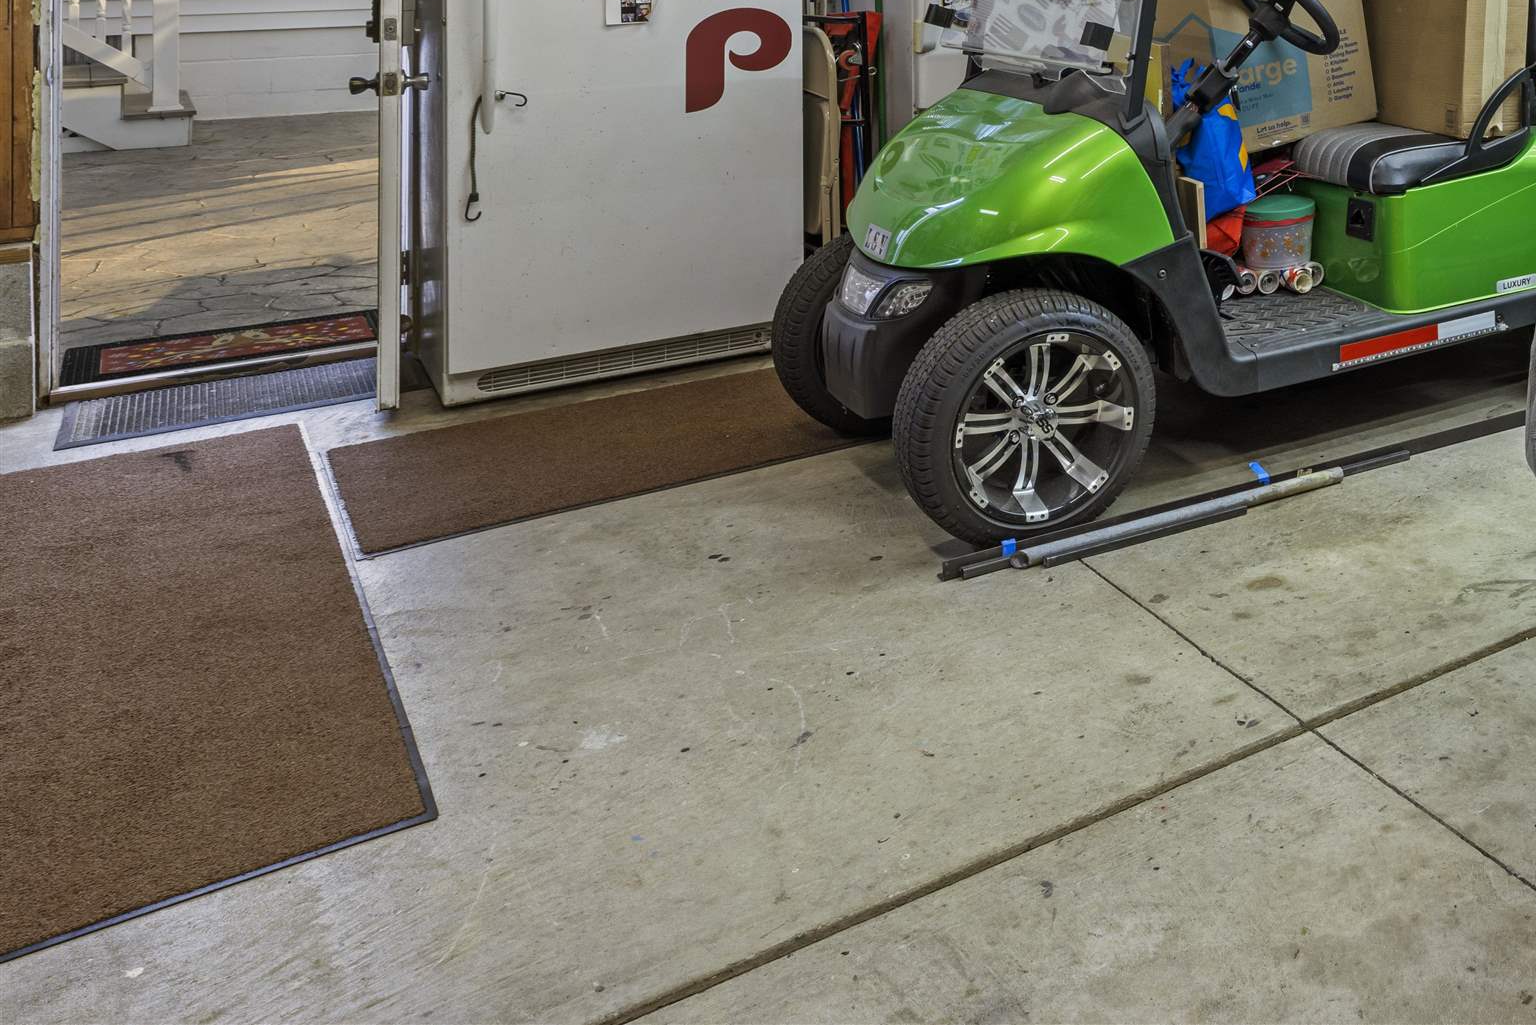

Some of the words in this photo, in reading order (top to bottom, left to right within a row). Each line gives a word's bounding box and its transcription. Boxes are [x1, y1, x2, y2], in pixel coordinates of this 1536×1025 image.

[685, 7, 793, 114] P
[1239, 58, 1296, 86] arge
[1503, 277, 1531, 290] LUXURY
